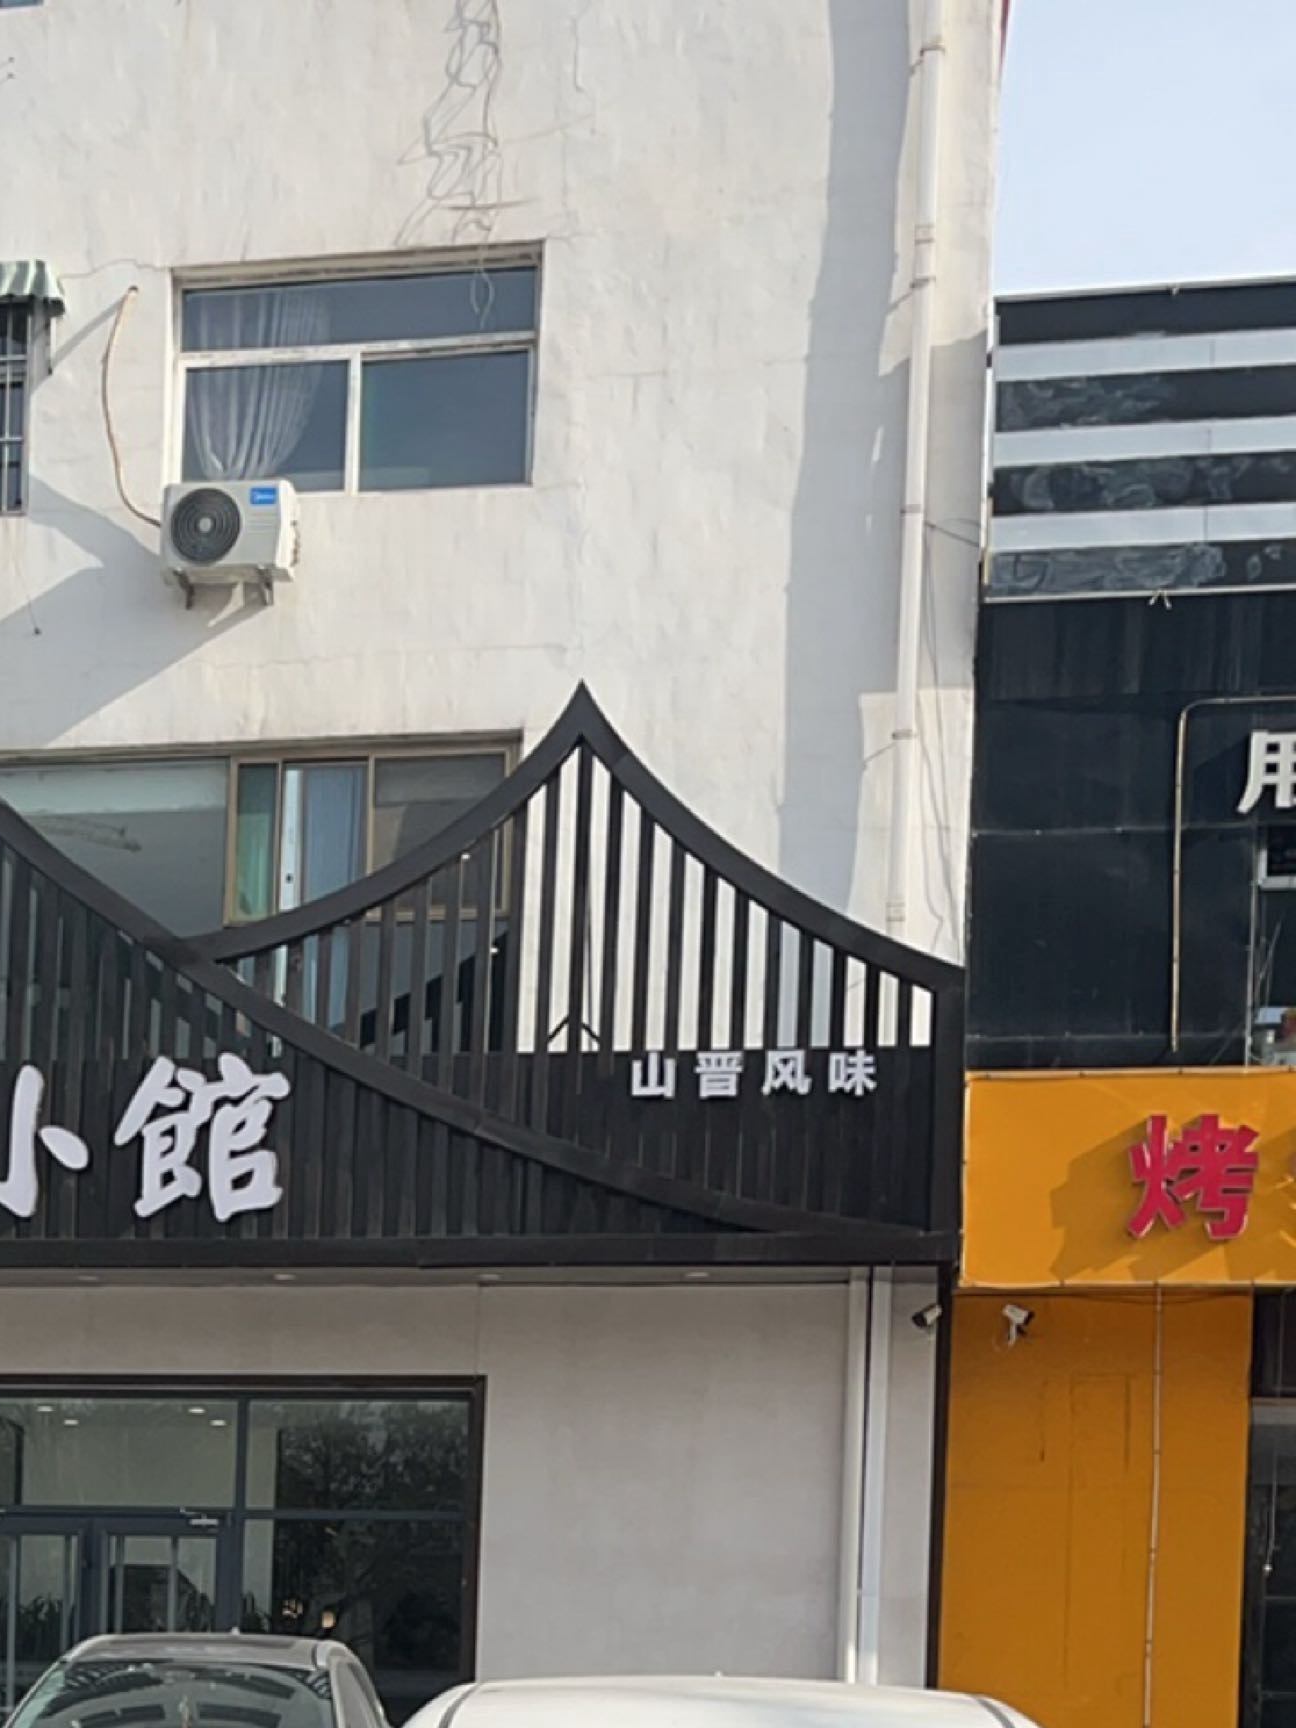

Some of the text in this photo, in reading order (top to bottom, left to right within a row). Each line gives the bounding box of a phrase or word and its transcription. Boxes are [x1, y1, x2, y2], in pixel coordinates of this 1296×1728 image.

[631, 1049, 877, 1098] 山晋风味
[1128, 1113, 1259, 1239] 烤
